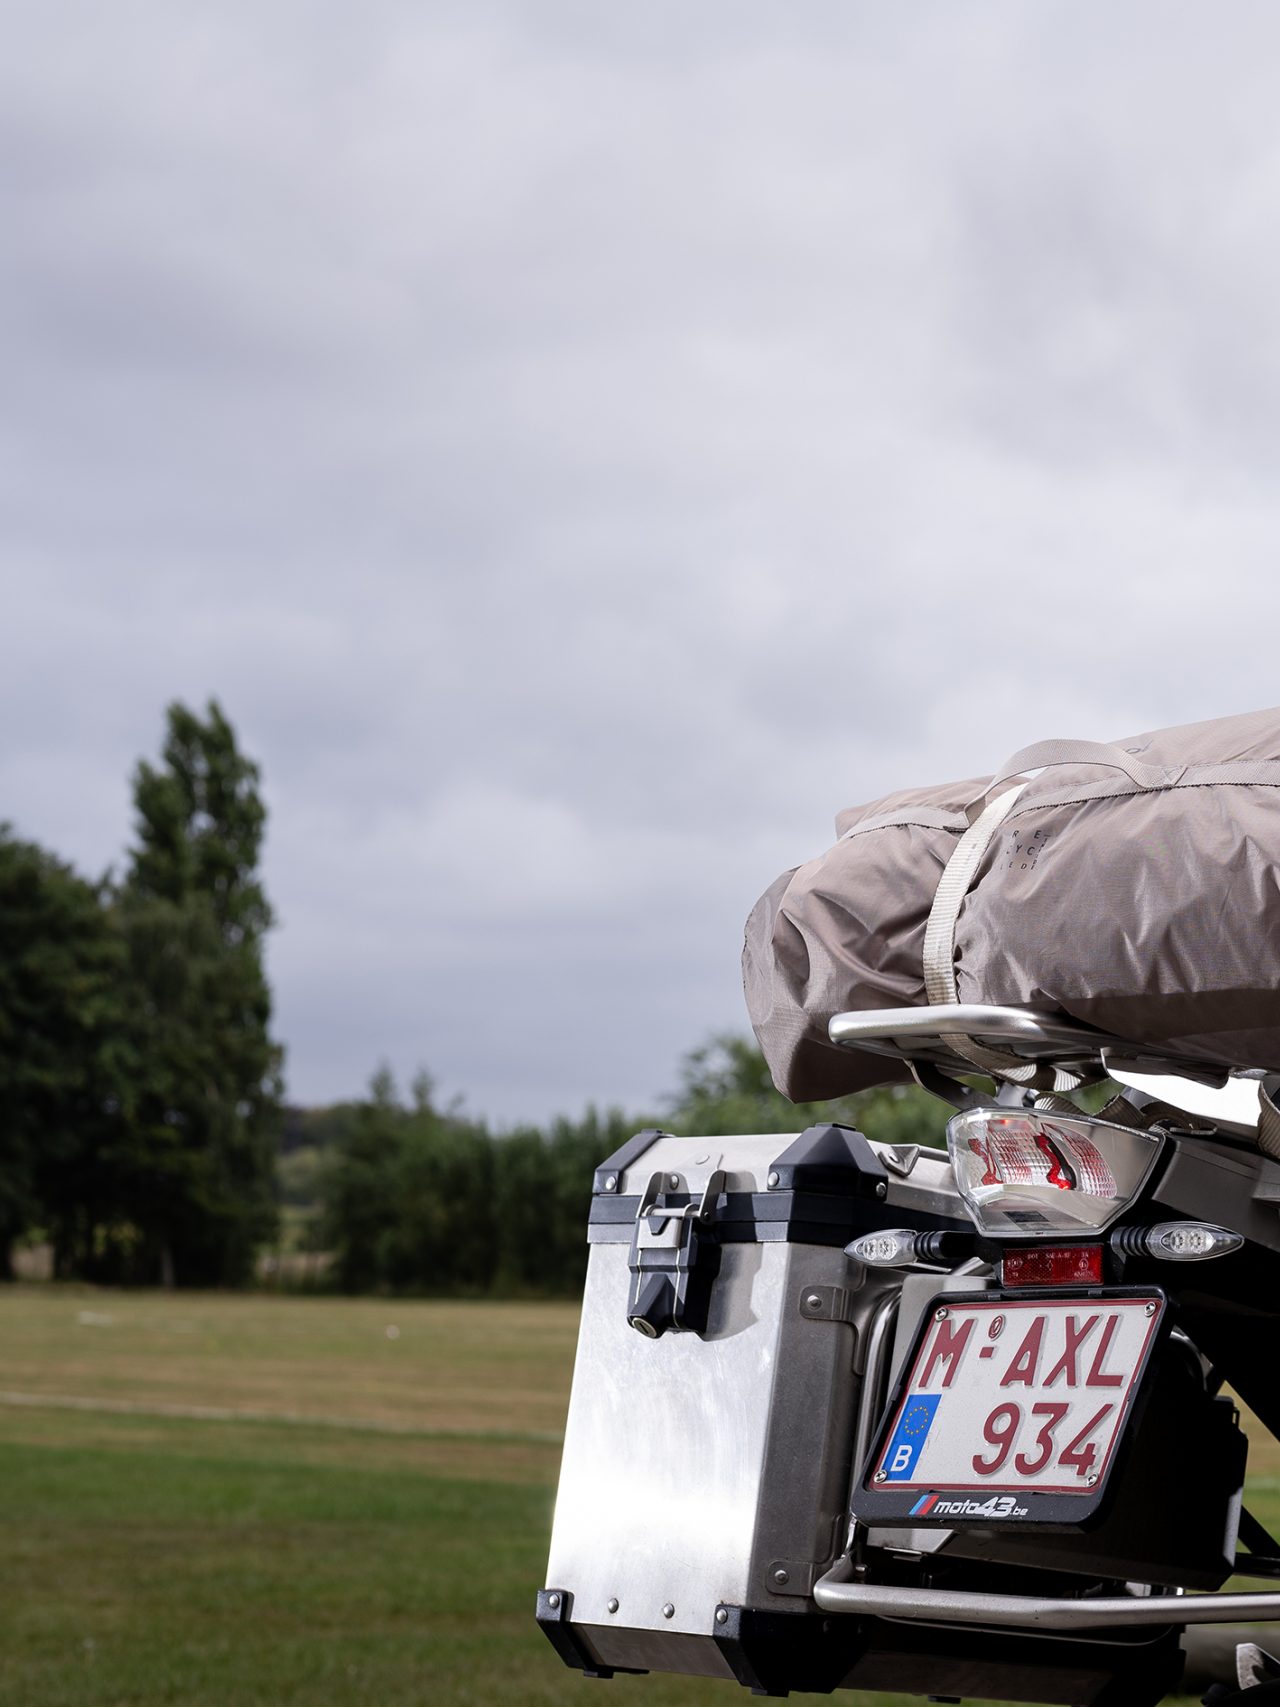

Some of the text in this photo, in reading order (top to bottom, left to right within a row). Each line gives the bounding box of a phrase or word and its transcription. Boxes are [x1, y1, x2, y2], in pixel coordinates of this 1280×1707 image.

[972, 1402, 1114, 1476] 934
[890, 1444, 913, 1472] B
[933, 1496, 1029, 1517] moto43.be
